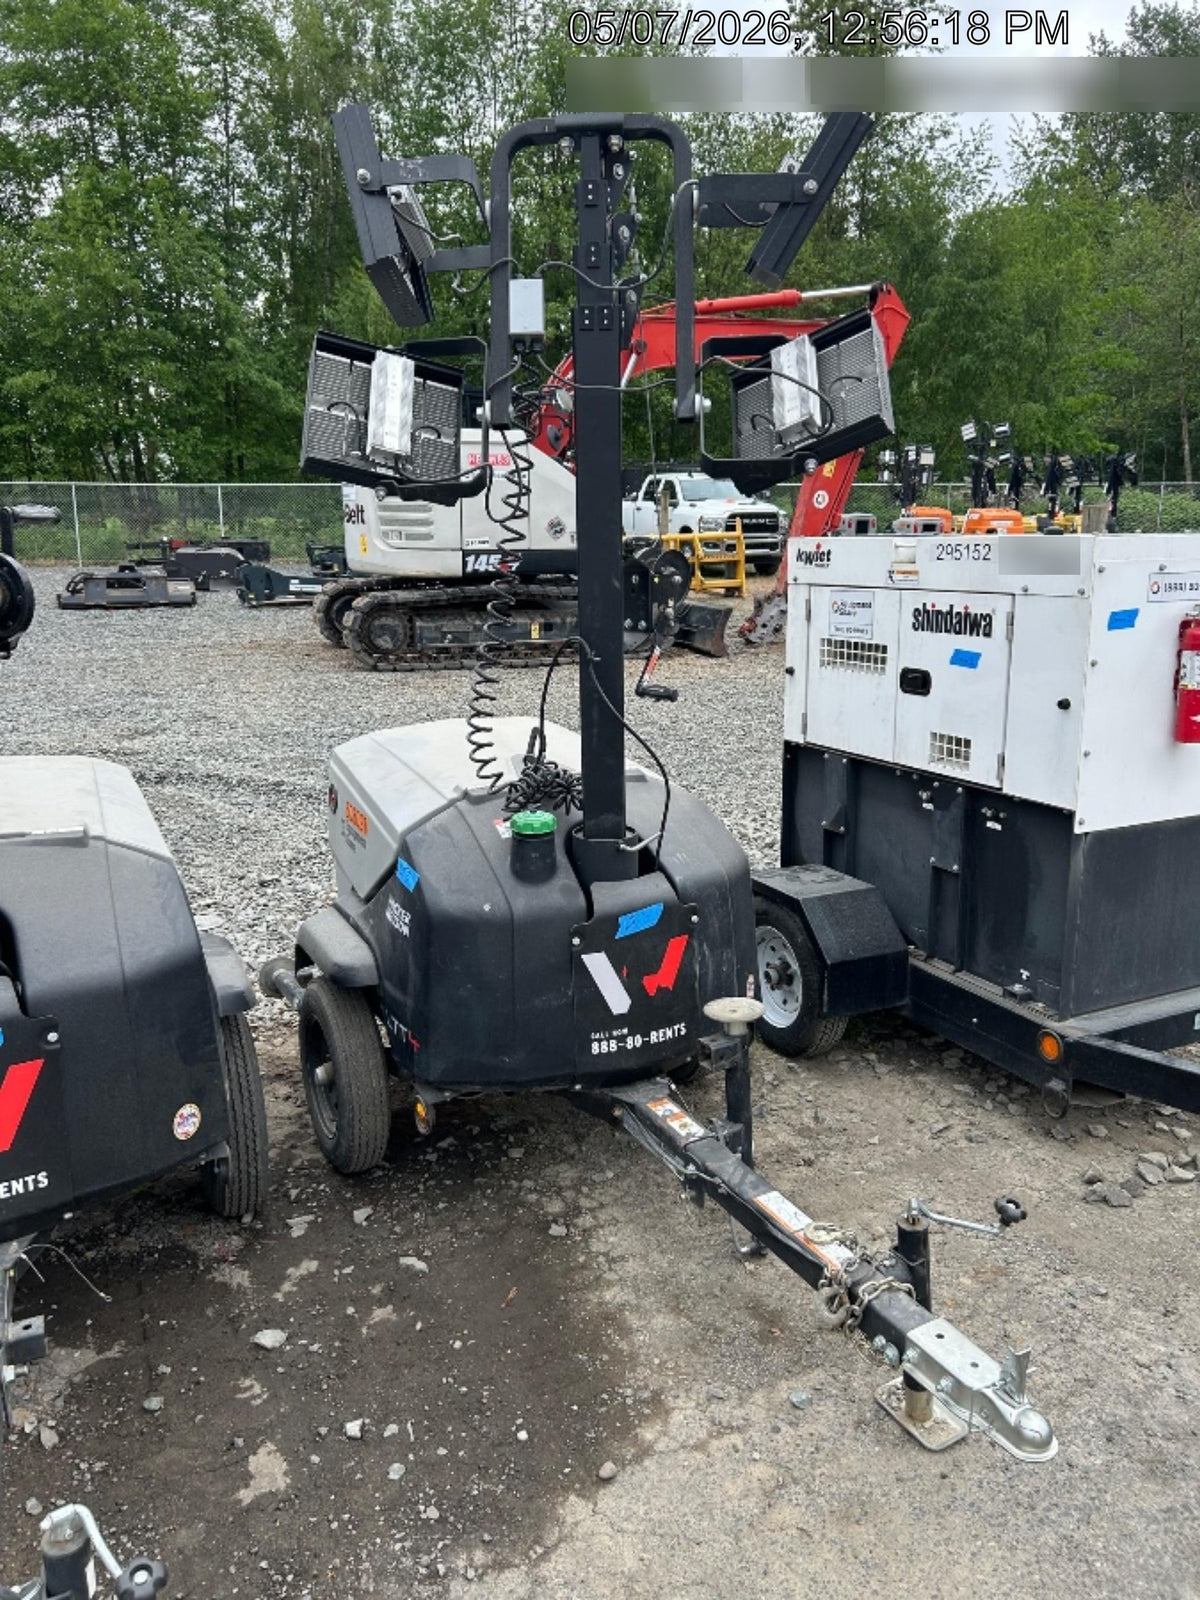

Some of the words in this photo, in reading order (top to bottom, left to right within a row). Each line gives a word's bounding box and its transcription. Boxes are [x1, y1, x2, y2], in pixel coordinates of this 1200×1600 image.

[936, 543, 991, 561] 295152
[912, 602, 993, 638] shindaiwa
[590, 1022, 687, 1055] 888-80-RENTS
[0, 1170, 49, 1199] ENTS
